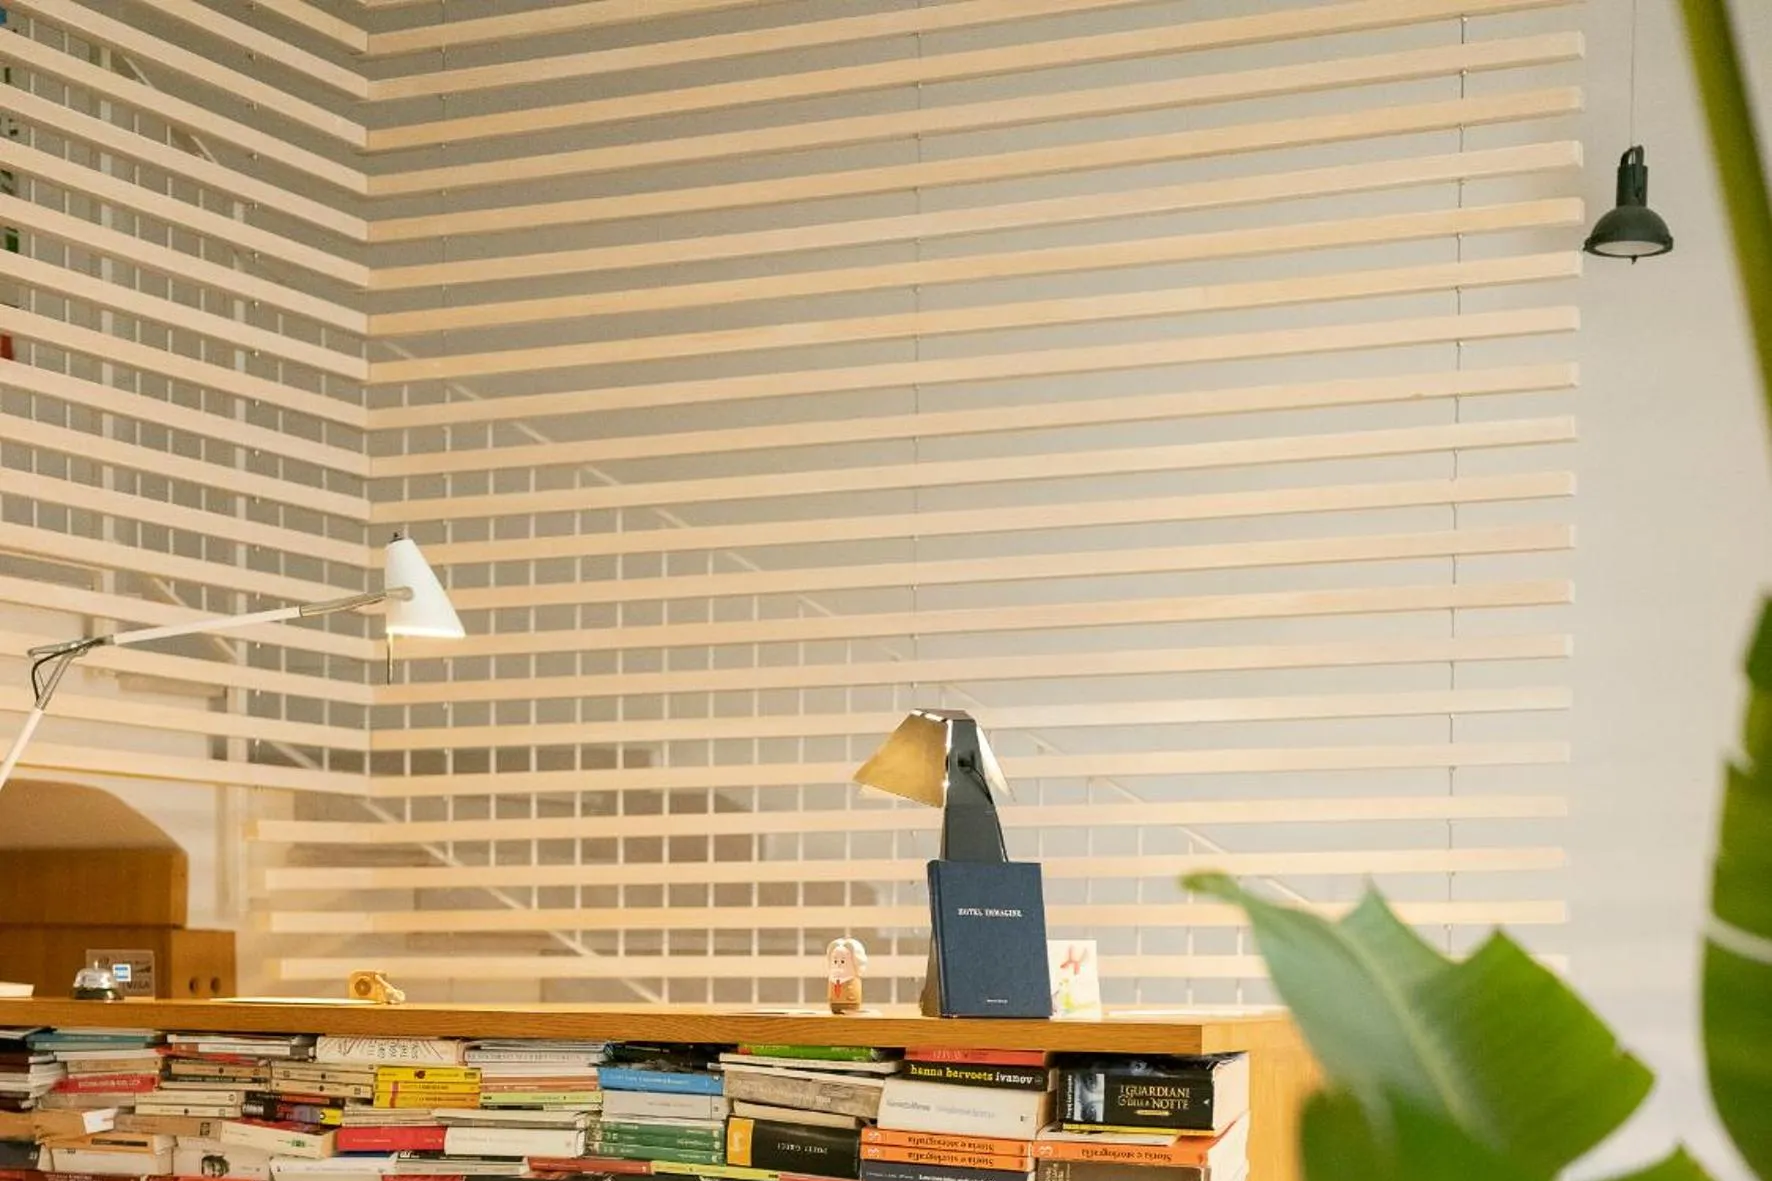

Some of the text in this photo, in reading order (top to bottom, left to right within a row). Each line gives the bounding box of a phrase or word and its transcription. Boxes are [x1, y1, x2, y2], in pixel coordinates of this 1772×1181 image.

[958, 908, 983, 916] HOTEL
[910, 1064, 1034, 1084] hanna bervoets ivanov
[1124, 1085, 1190, 1098] GUARDIANI
[1152, 1098, 1190, 1110] NOTTE
[968, 1140, 994, 1152] Storia
[1082, 1148, 1136, 1158] storiografia
[1144, 1152, 1172, 1162] Storia
[968, 1156, 994, 1166] Storia
